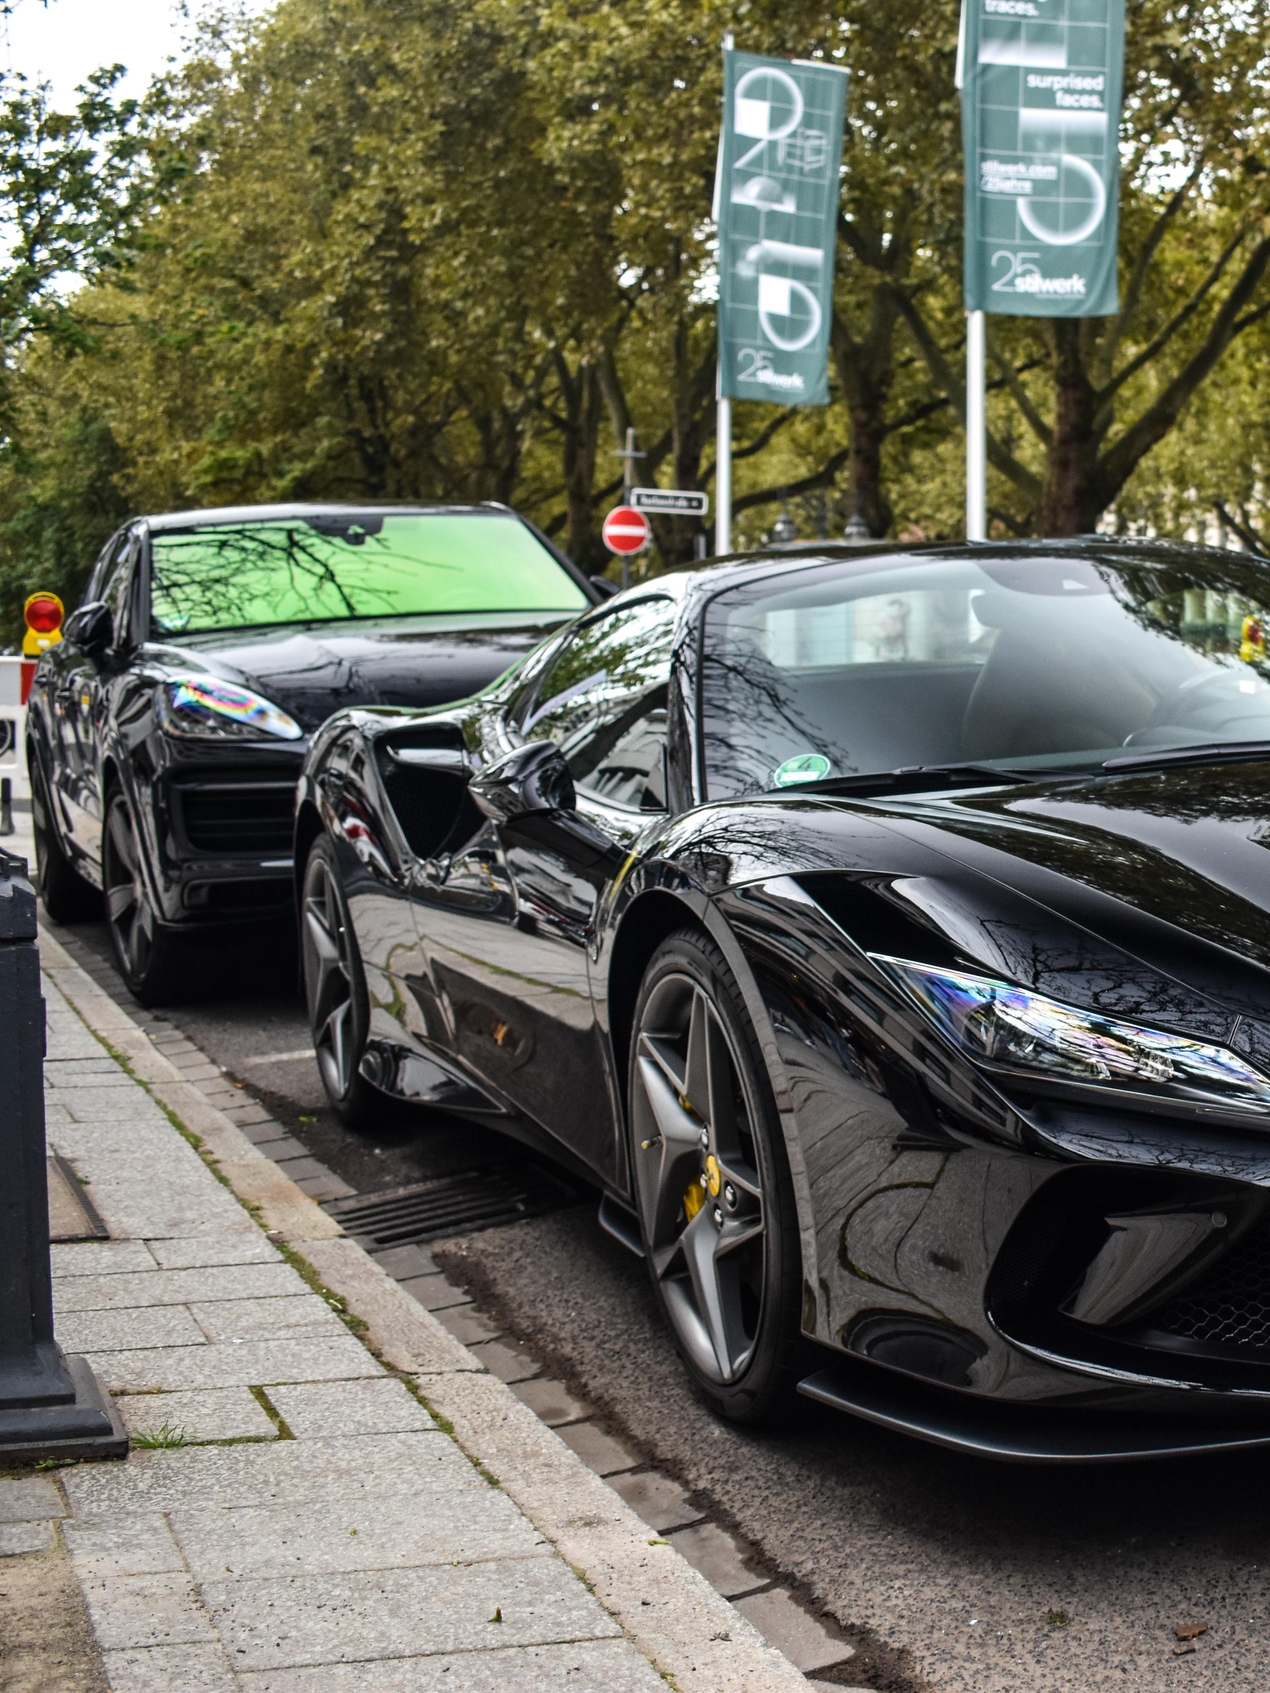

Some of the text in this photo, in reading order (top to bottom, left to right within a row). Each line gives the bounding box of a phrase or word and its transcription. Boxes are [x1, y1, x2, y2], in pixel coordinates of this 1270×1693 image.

[984, 0, 1040, 17] traces.
[1026, 72, 1105, 92] surprised
[1055, 90, 1104, 108] faces.
[991, 250, 1042, 292] 25
[737, 347, 776, 382] 25
[798, 756, 811, 771] 4
